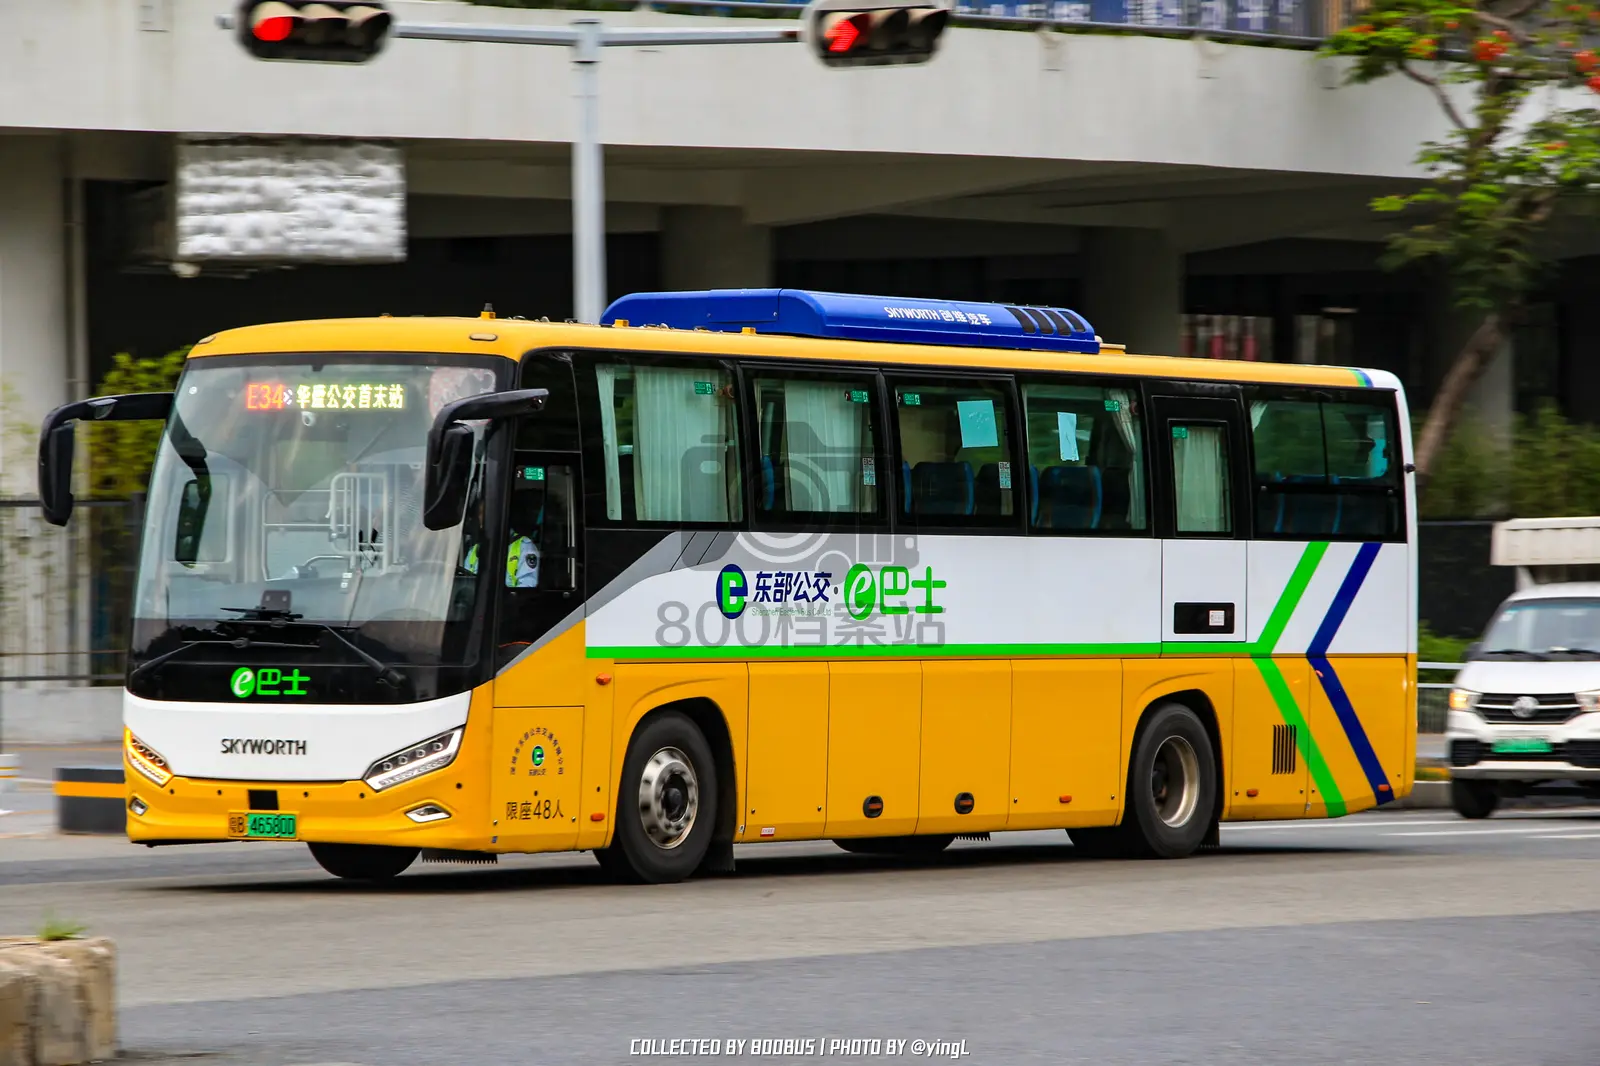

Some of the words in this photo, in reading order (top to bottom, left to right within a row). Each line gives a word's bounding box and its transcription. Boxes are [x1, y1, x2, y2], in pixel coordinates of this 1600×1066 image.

[883, 306, 941, 321] SKYWORTH
[939, 309, 992, 326] 创维汽车
[246, 383, 284, 410] E34
[220, 738, 308, 756] SKYWORTH
[506, 799, 564, 821] 限座48人
